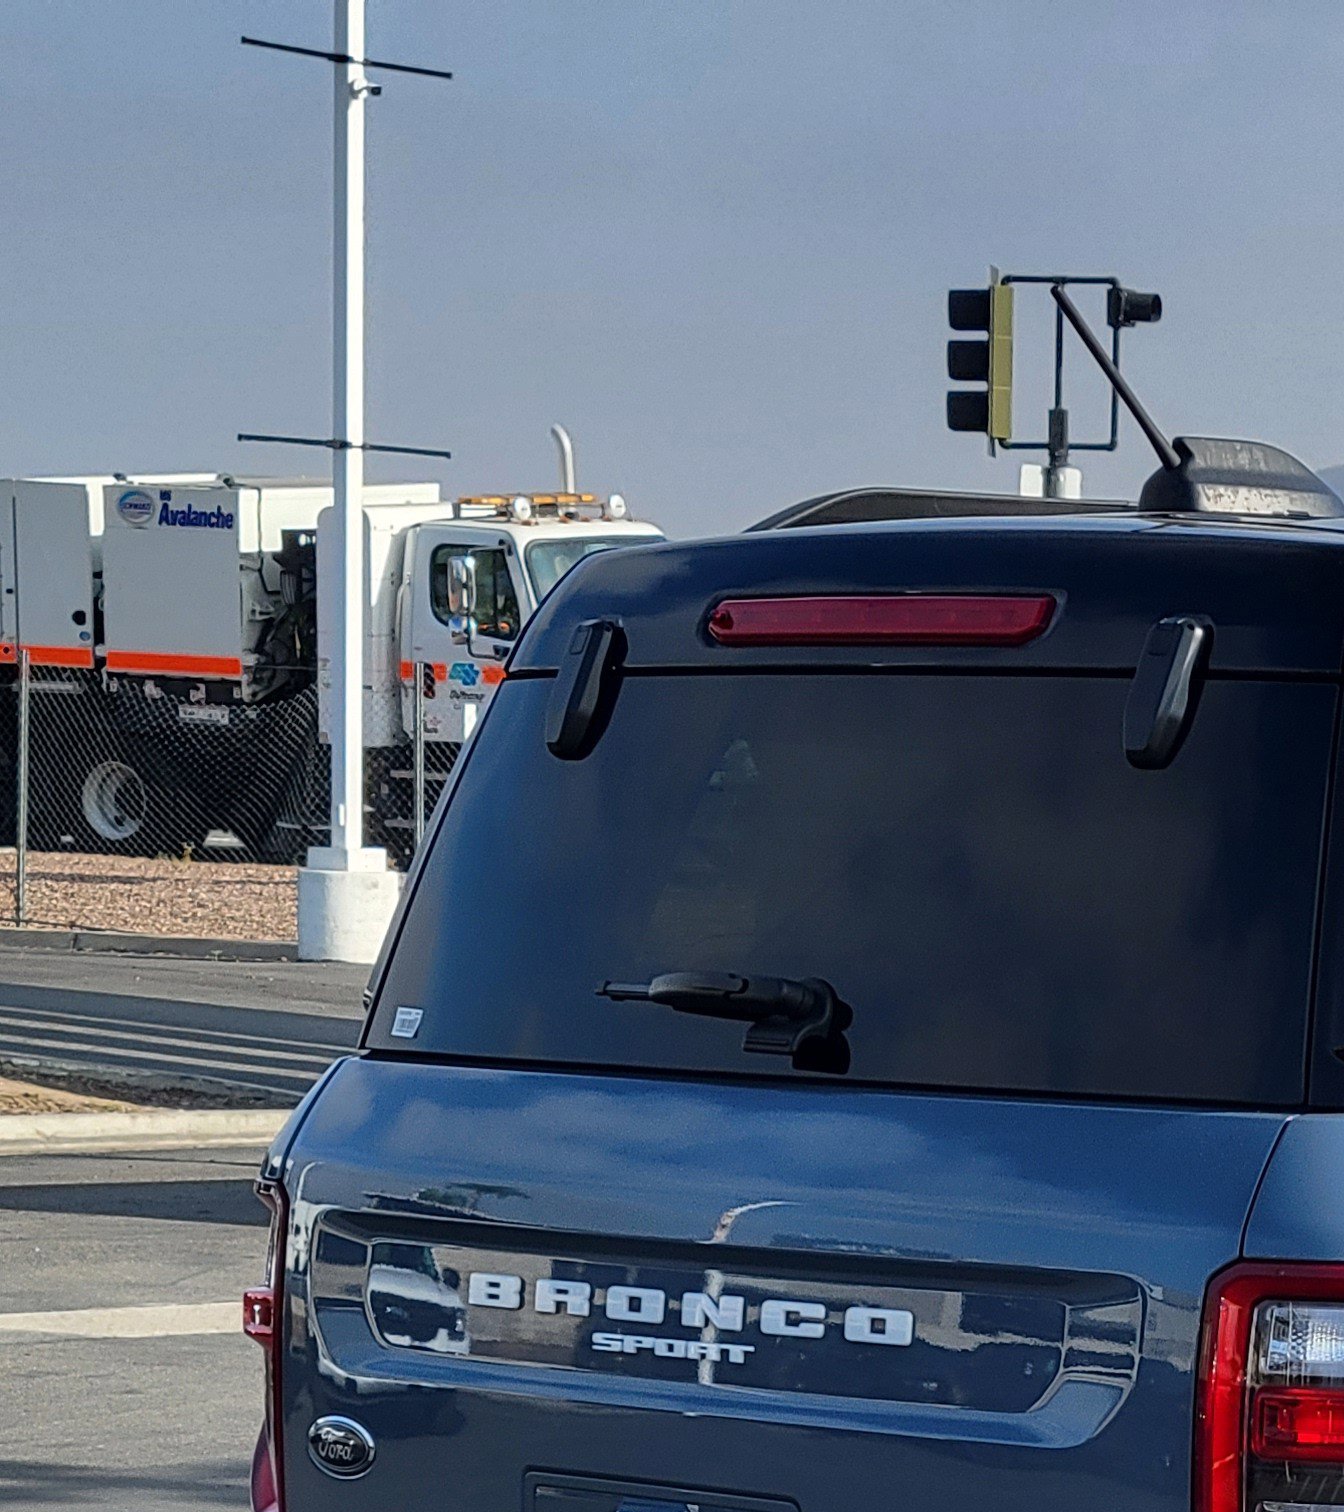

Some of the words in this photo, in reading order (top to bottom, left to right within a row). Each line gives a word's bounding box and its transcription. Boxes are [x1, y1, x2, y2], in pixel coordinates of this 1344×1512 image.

[158, 502, 234, 529] Avalanche
[467, 1271, 915, 1347] BRONCO
[590, 1331, 756, 1365] SPORT
[316, 1426, 356, 1461] Ford
